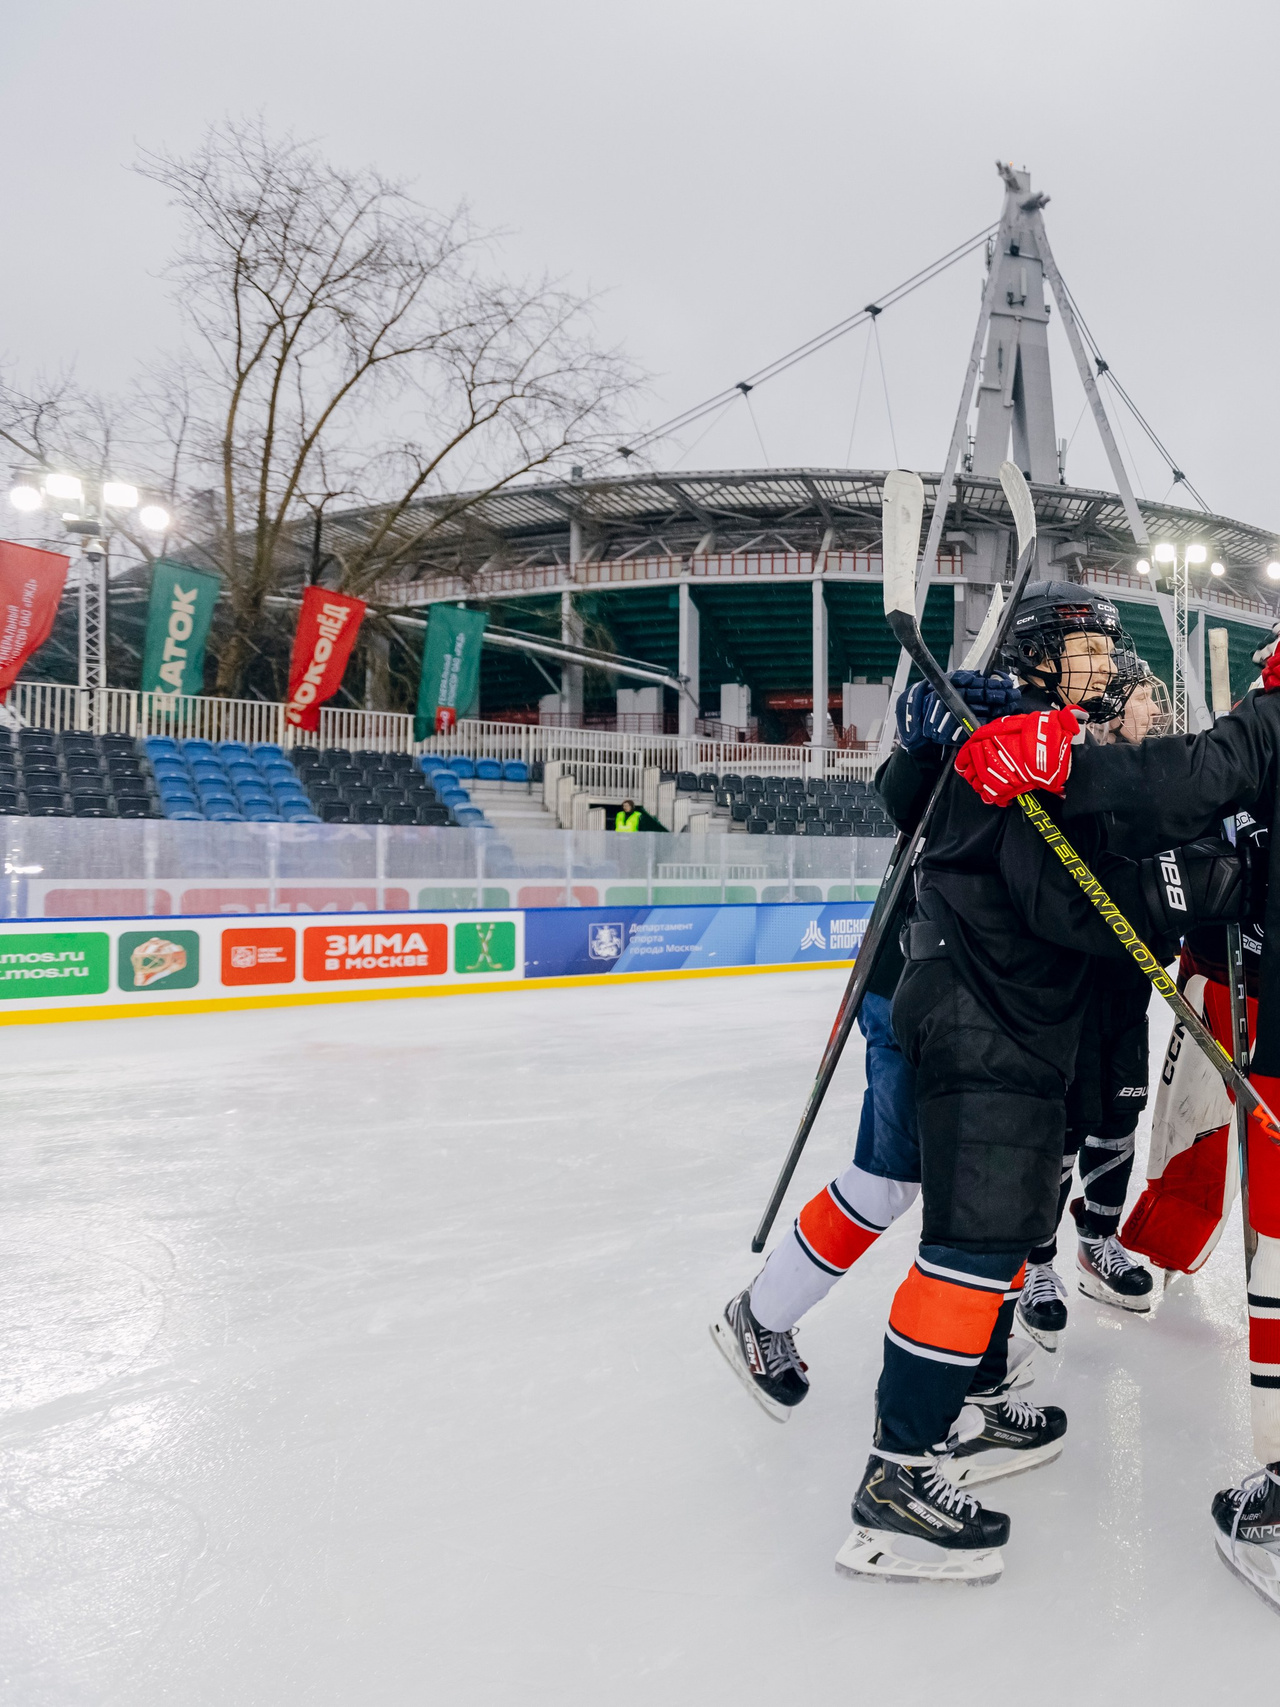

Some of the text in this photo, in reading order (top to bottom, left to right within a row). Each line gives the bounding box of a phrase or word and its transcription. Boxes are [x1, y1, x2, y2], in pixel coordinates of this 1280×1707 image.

[1097, 603, 1116, 614] CCM
[1016, 615, 1035, 625] CCM
[151, 583, 199, 713] КАТОК
[1017, 791, 1177, 998] SHERWOOD
[629, 922, 694, 934] Департамент
[830, 918, 870, 934] МОСКО
[324, 932, 428, 957] ЗИМА
[629, 935, 664, 946] спорта
[830, 934, 864, 950] СПОРТ
[629, 943, 703, 956] города Москвы
[324, 954, 429, 971] В МОСКВЕ
[993, 1430, 1023, 1443] BAUER
[906, 1501, 943, 1530] BAUER
